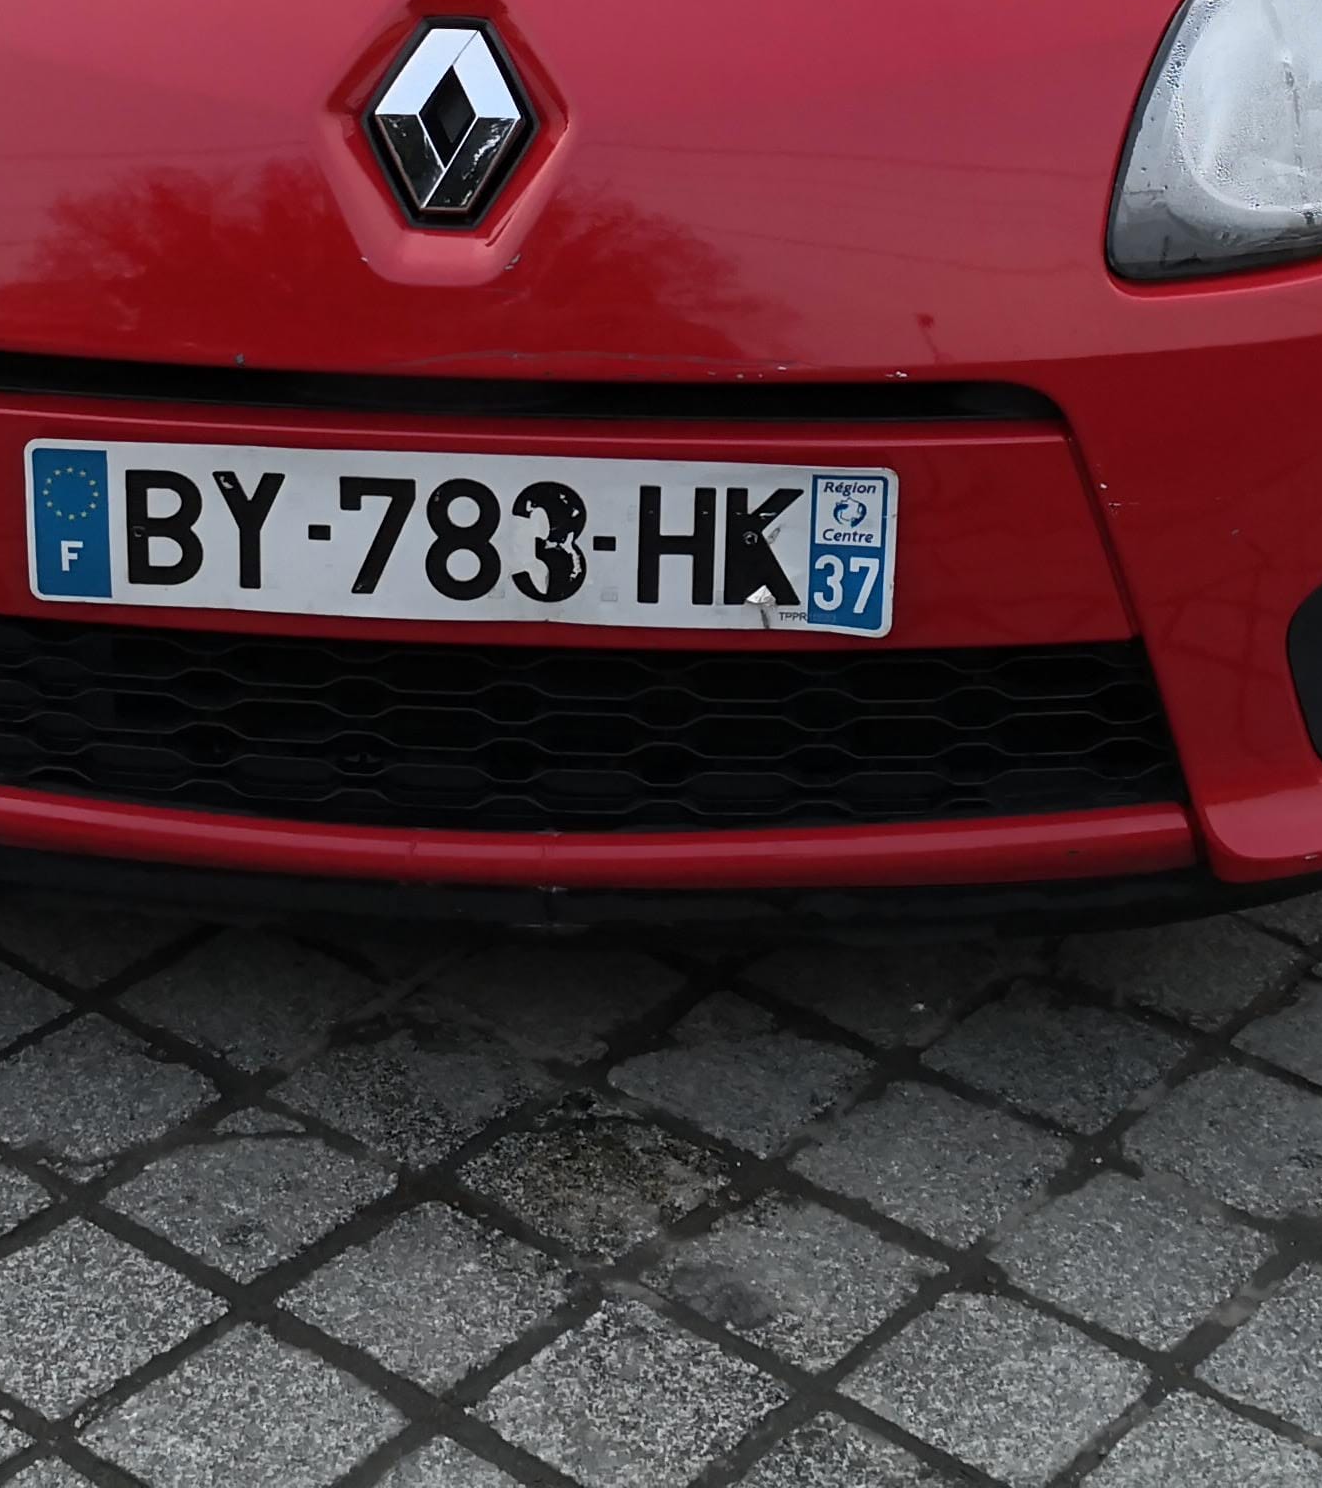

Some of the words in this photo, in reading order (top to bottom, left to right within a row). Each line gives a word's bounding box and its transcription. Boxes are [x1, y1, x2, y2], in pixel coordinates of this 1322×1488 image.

[823, 481, 877, 497] Région
[125, 469, 805, 607] BY-783-HK
[822, 528, 874, 544] Centre
[60, 540, 84, 572] F
[813, 554, 880, 615] 37
